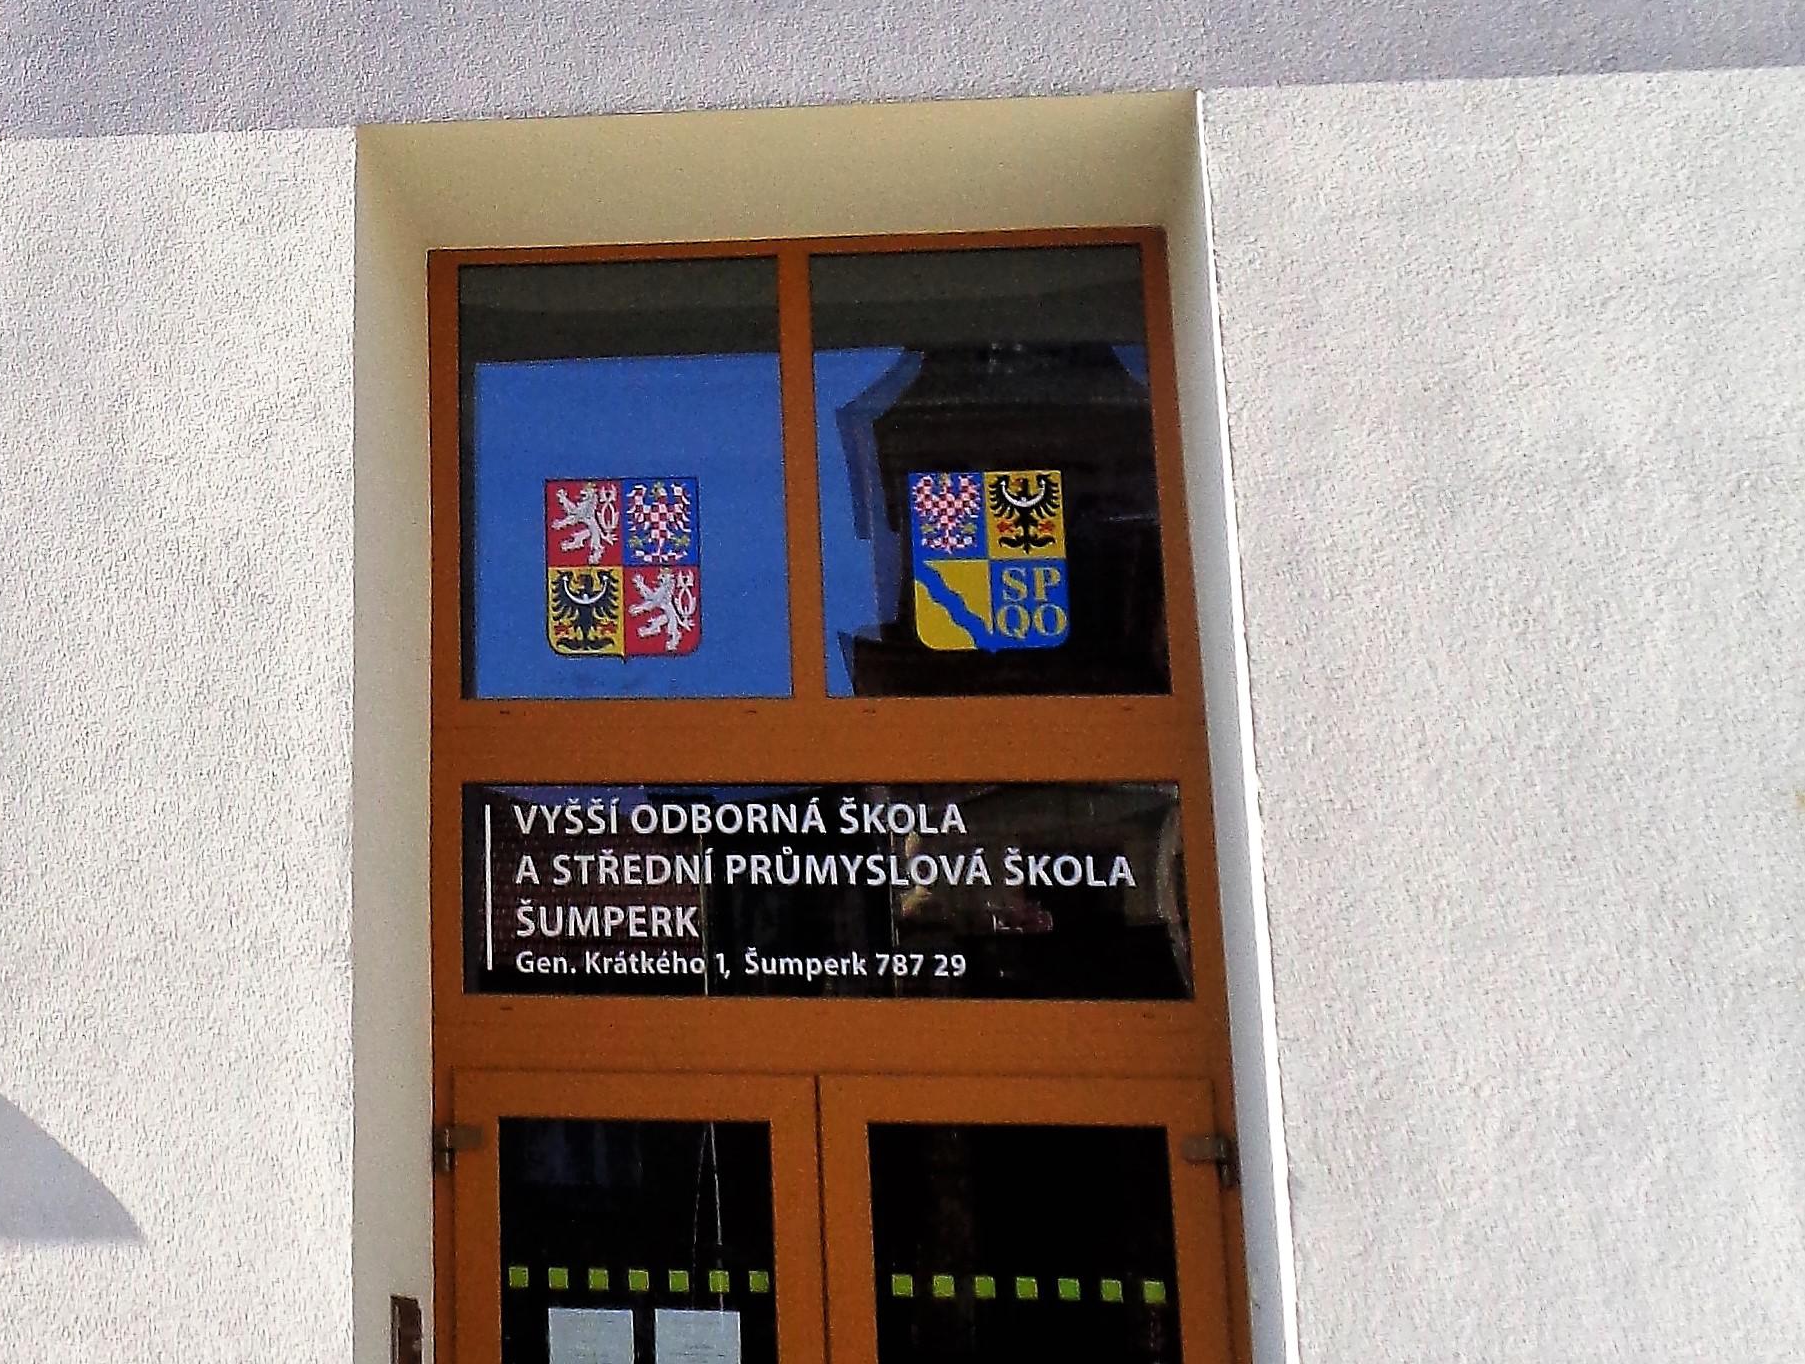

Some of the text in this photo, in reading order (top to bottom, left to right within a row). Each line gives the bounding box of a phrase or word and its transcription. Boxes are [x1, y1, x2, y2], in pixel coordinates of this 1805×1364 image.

[1002, 567, 1061, 602] SP
[997, 603, 1068, 639] QO
[513, 797, 967, 835] VYŠŠÍ ODBORNÁ ŠKOLA
[515, 846, 1137, 888] A STŘEDNÍ PRŮMYSLOVÁ ŠKOLA
[515, 898, 700, 938] ŠUMPERK
[515, 946, 967, 982] Gen. Krátkého 1, Šumperk 787 29
